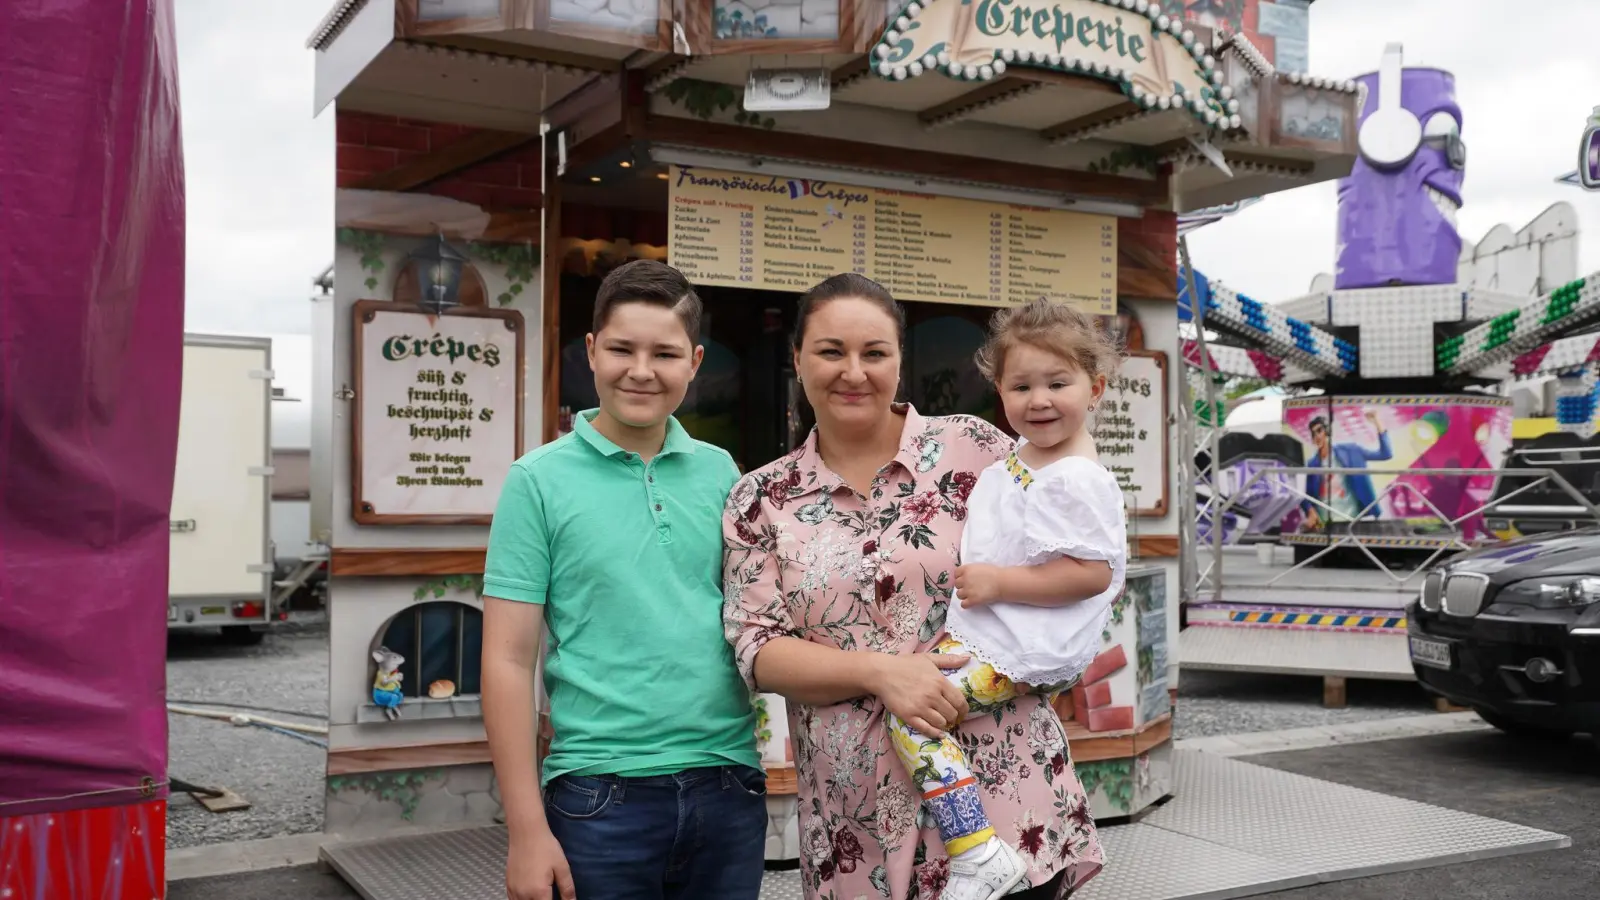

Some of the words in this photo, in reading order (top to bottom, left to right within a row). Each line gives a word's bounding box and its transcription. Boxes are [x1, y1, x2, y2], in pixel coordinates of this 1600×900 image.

[675, 165, 787, 194] Französische
[811, 181, 869, 206] Crêpes
[764, 206, 818, 215] Kinderschokolade
[675, 224, 710, 233] Marmelade
[675, 234, 704, 243] Apfelmus
[675, 243, 717, 252] Pflaumenmus
[675, 252, 718, 261] Preiselbeeren
[707, 273, 736, 282] Apfelmus
[451, 371, 466, 385] &
[408, 387, 473, 405] fruchtig,
[1121, 401, 1130, 411] &
[387, 404, 474, 423] beschwipst
[478, 408, 494, 422] &
[409, 424, 471, 442] herzhaft
[1138, 430, 1147, 440] &
[409, 453, 431, 462] Wir
[434, 453, 471, 464] belegen
[415, 466, 438, 475] auch
[430, 476, 483, 487] Wünschen
